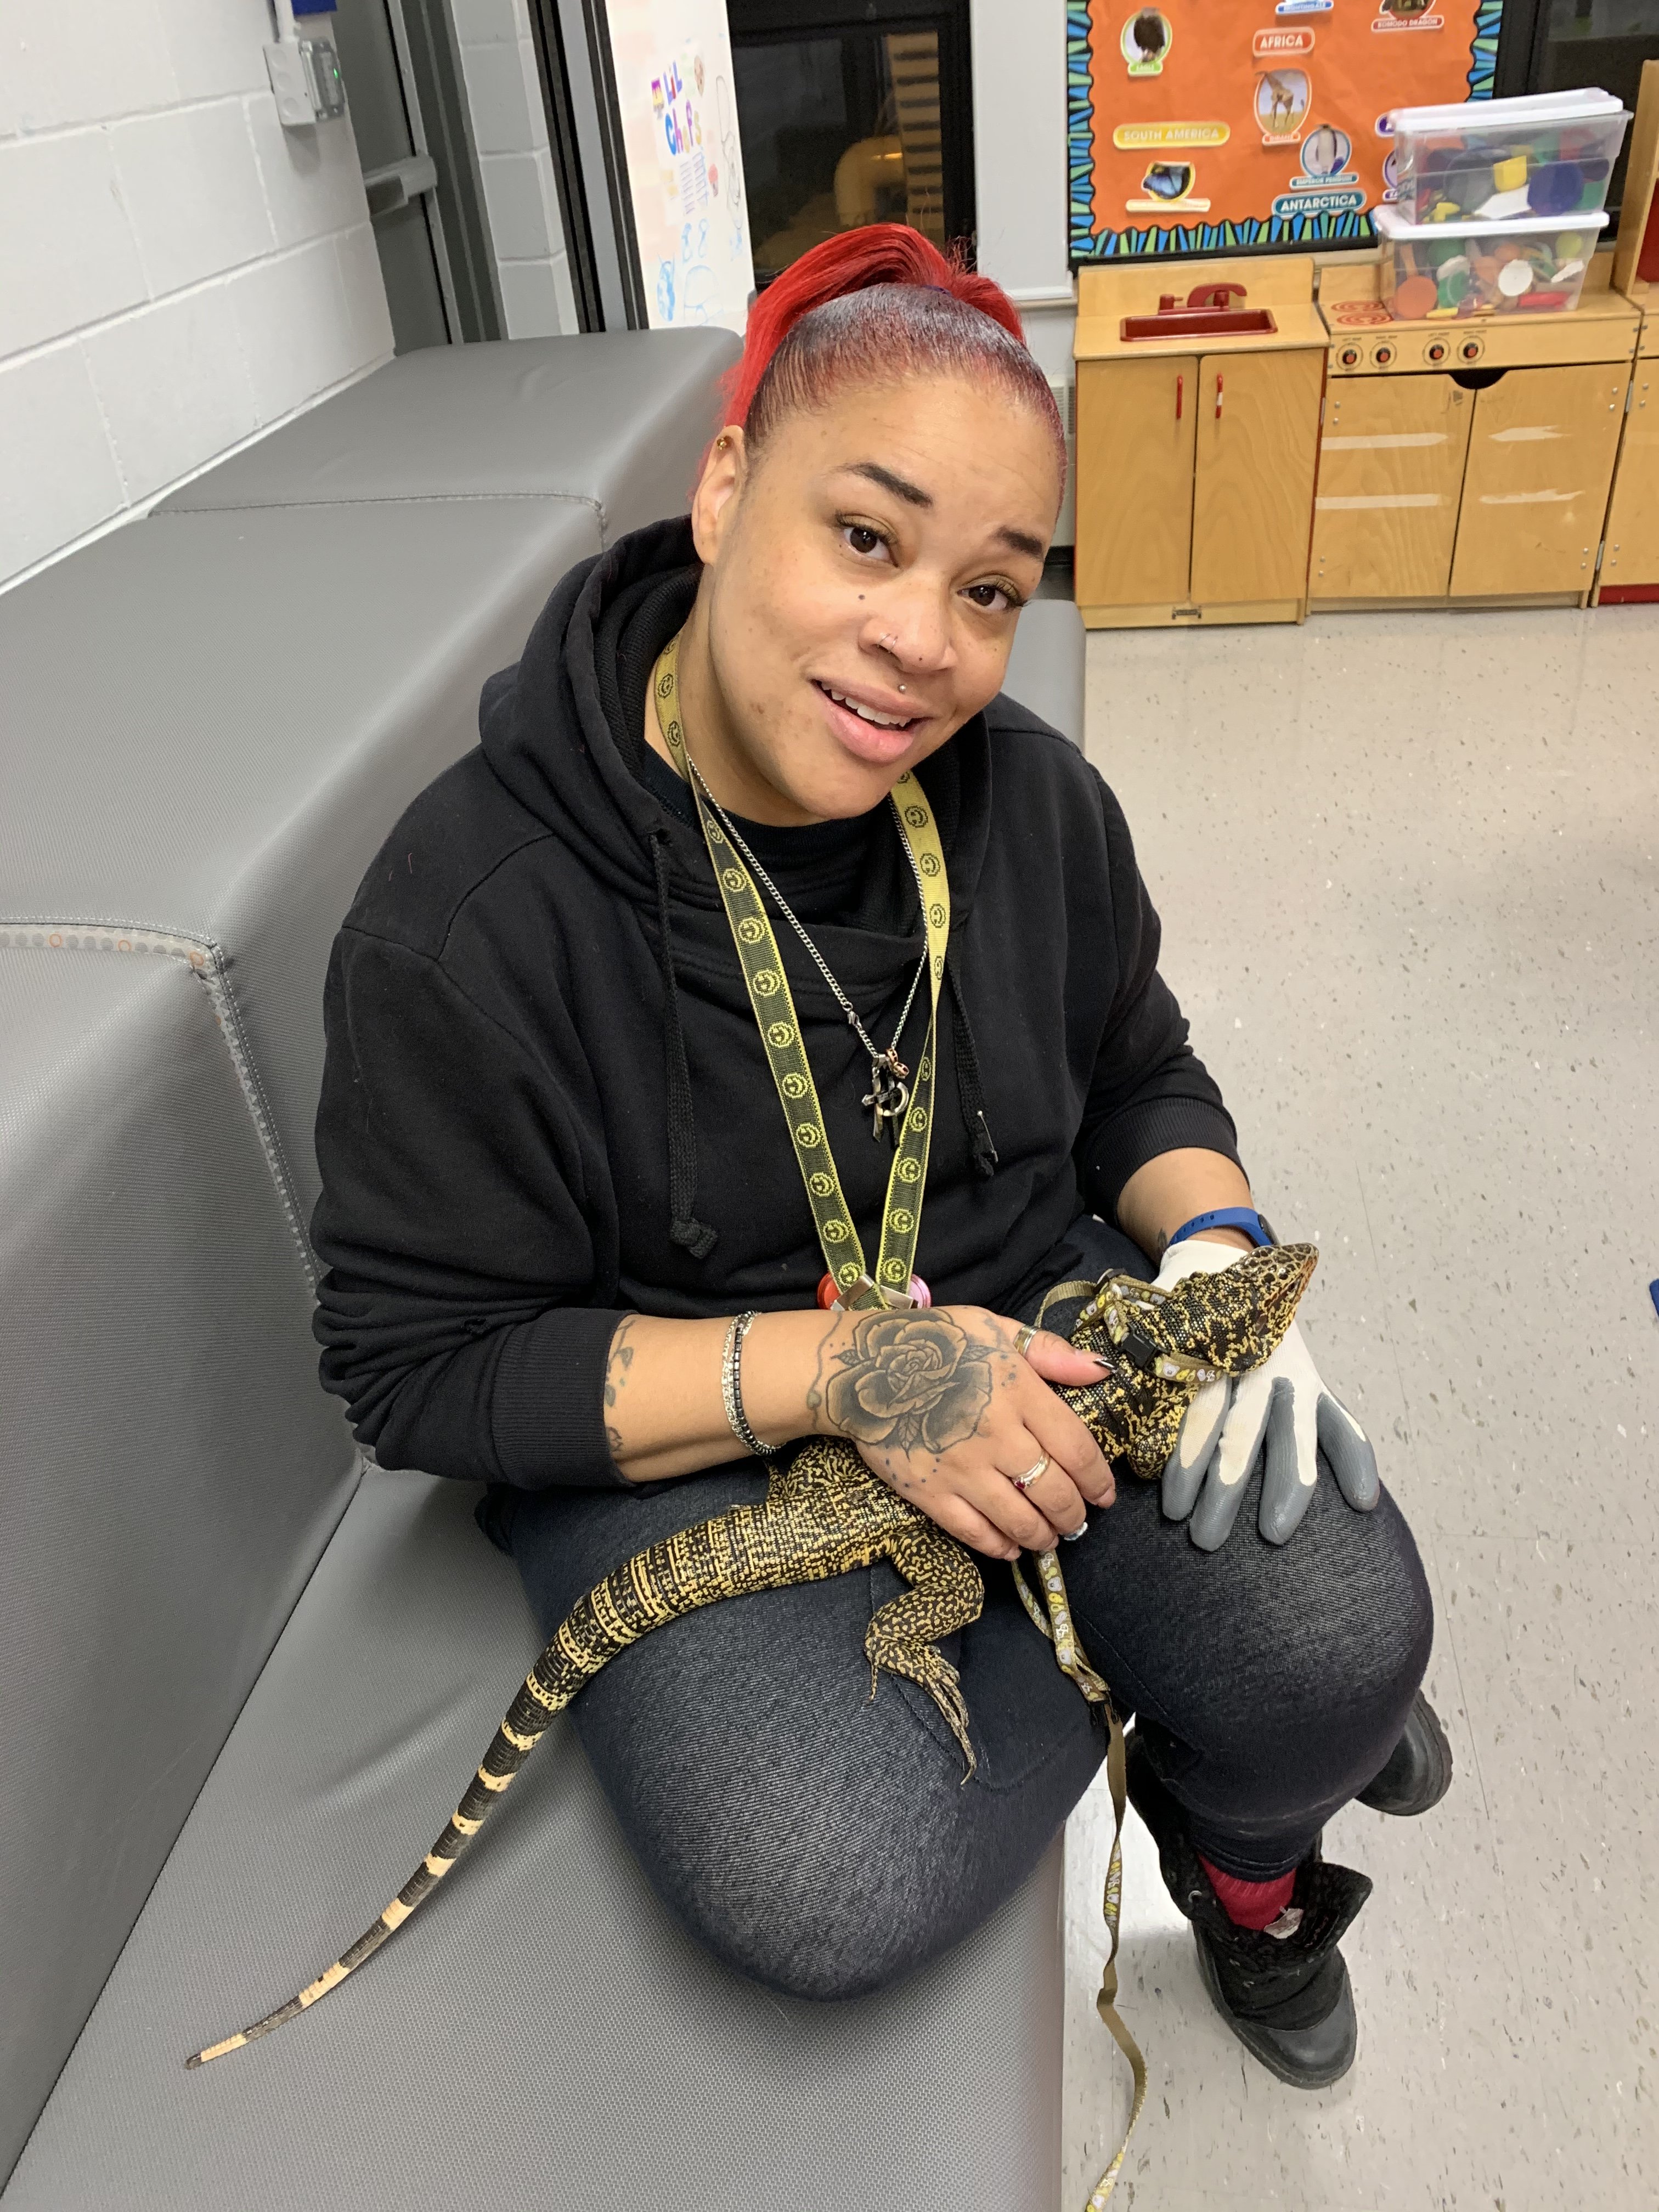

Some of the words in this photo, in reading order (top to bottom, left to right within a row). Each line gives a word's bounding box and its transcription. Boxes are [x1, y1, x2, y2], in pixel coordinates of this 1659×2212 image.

[1260, 35, 1304, 48] AFRICA
[1124, 130, 1162, 141] SOUTH
[1166, 128, 1219, 140] AMERICA
[1280, 194, 1357, 212] ANTARCTICA
